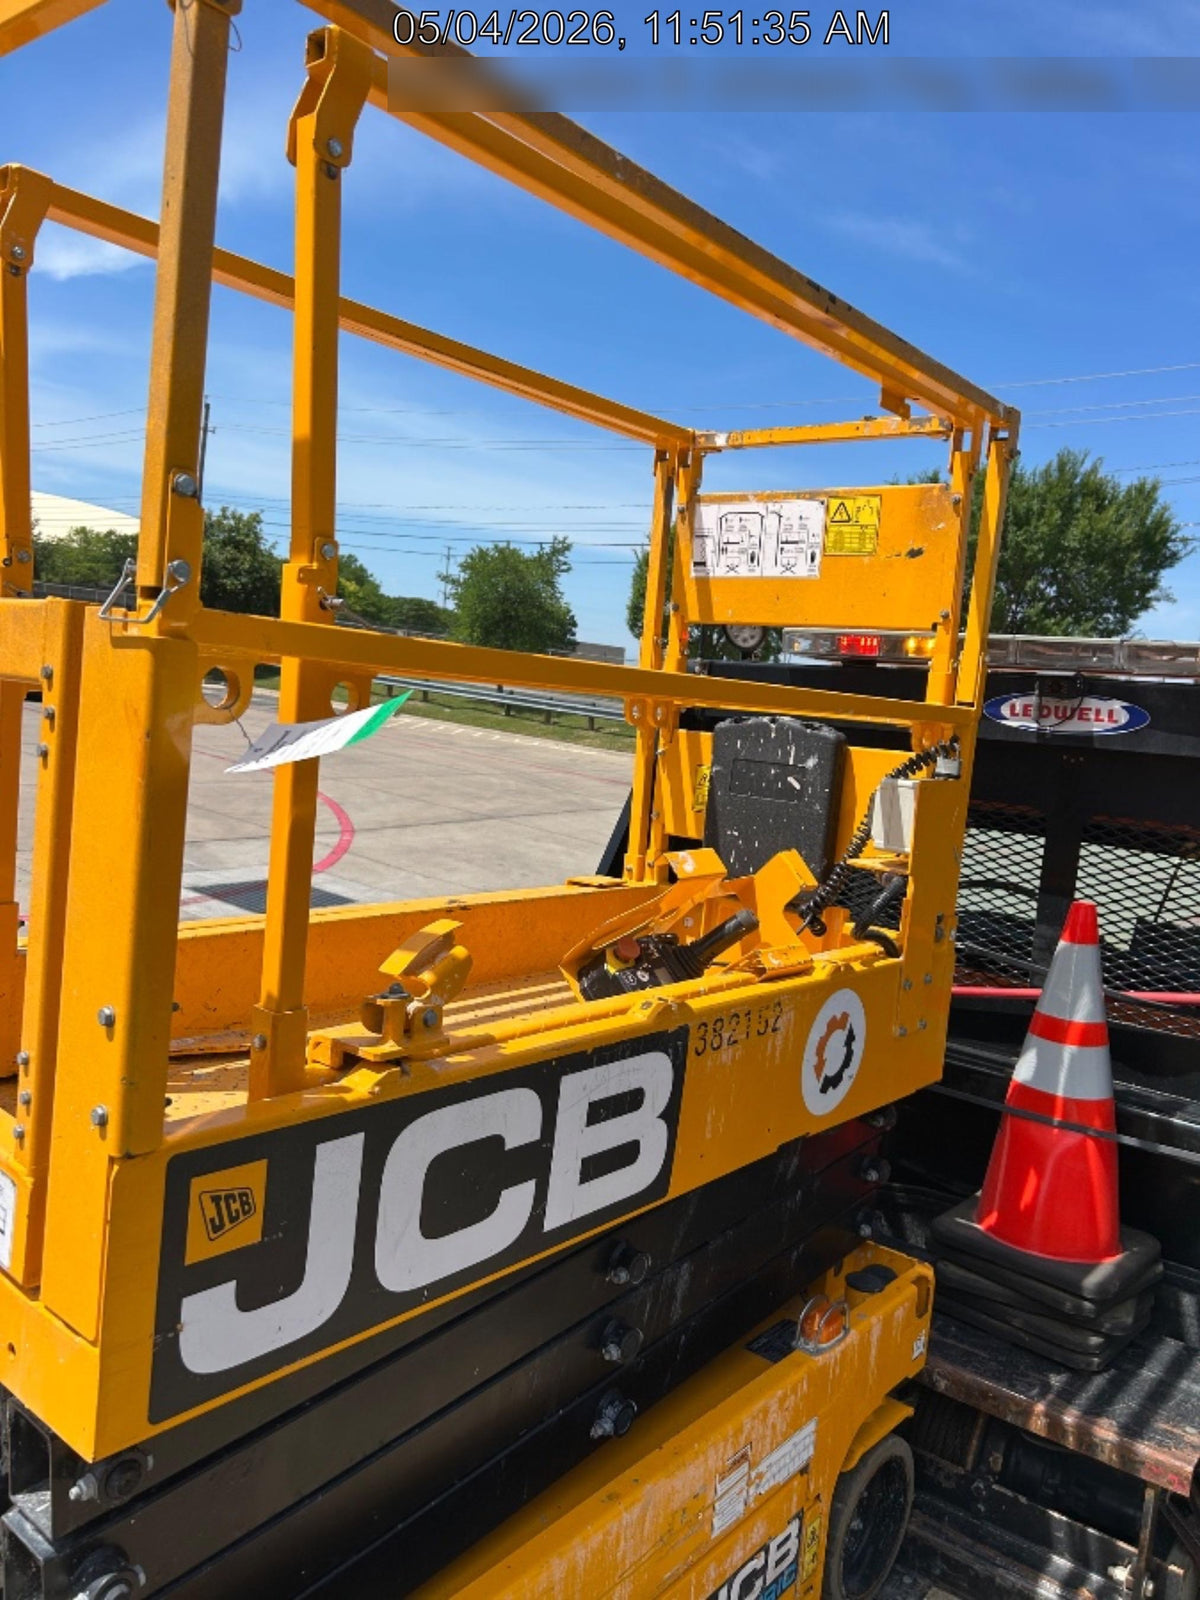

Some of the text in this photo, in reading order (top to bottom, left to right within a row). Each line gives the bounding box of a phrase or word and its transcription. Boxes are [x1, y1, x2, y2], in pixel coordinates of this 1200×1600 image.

[694, 1001, 784, 1057] 382152
[179, 1051, 675, 1374] JCB
[208, 1190, 253, 1234] JCB
[717, 1517, 800, 1600] CB
